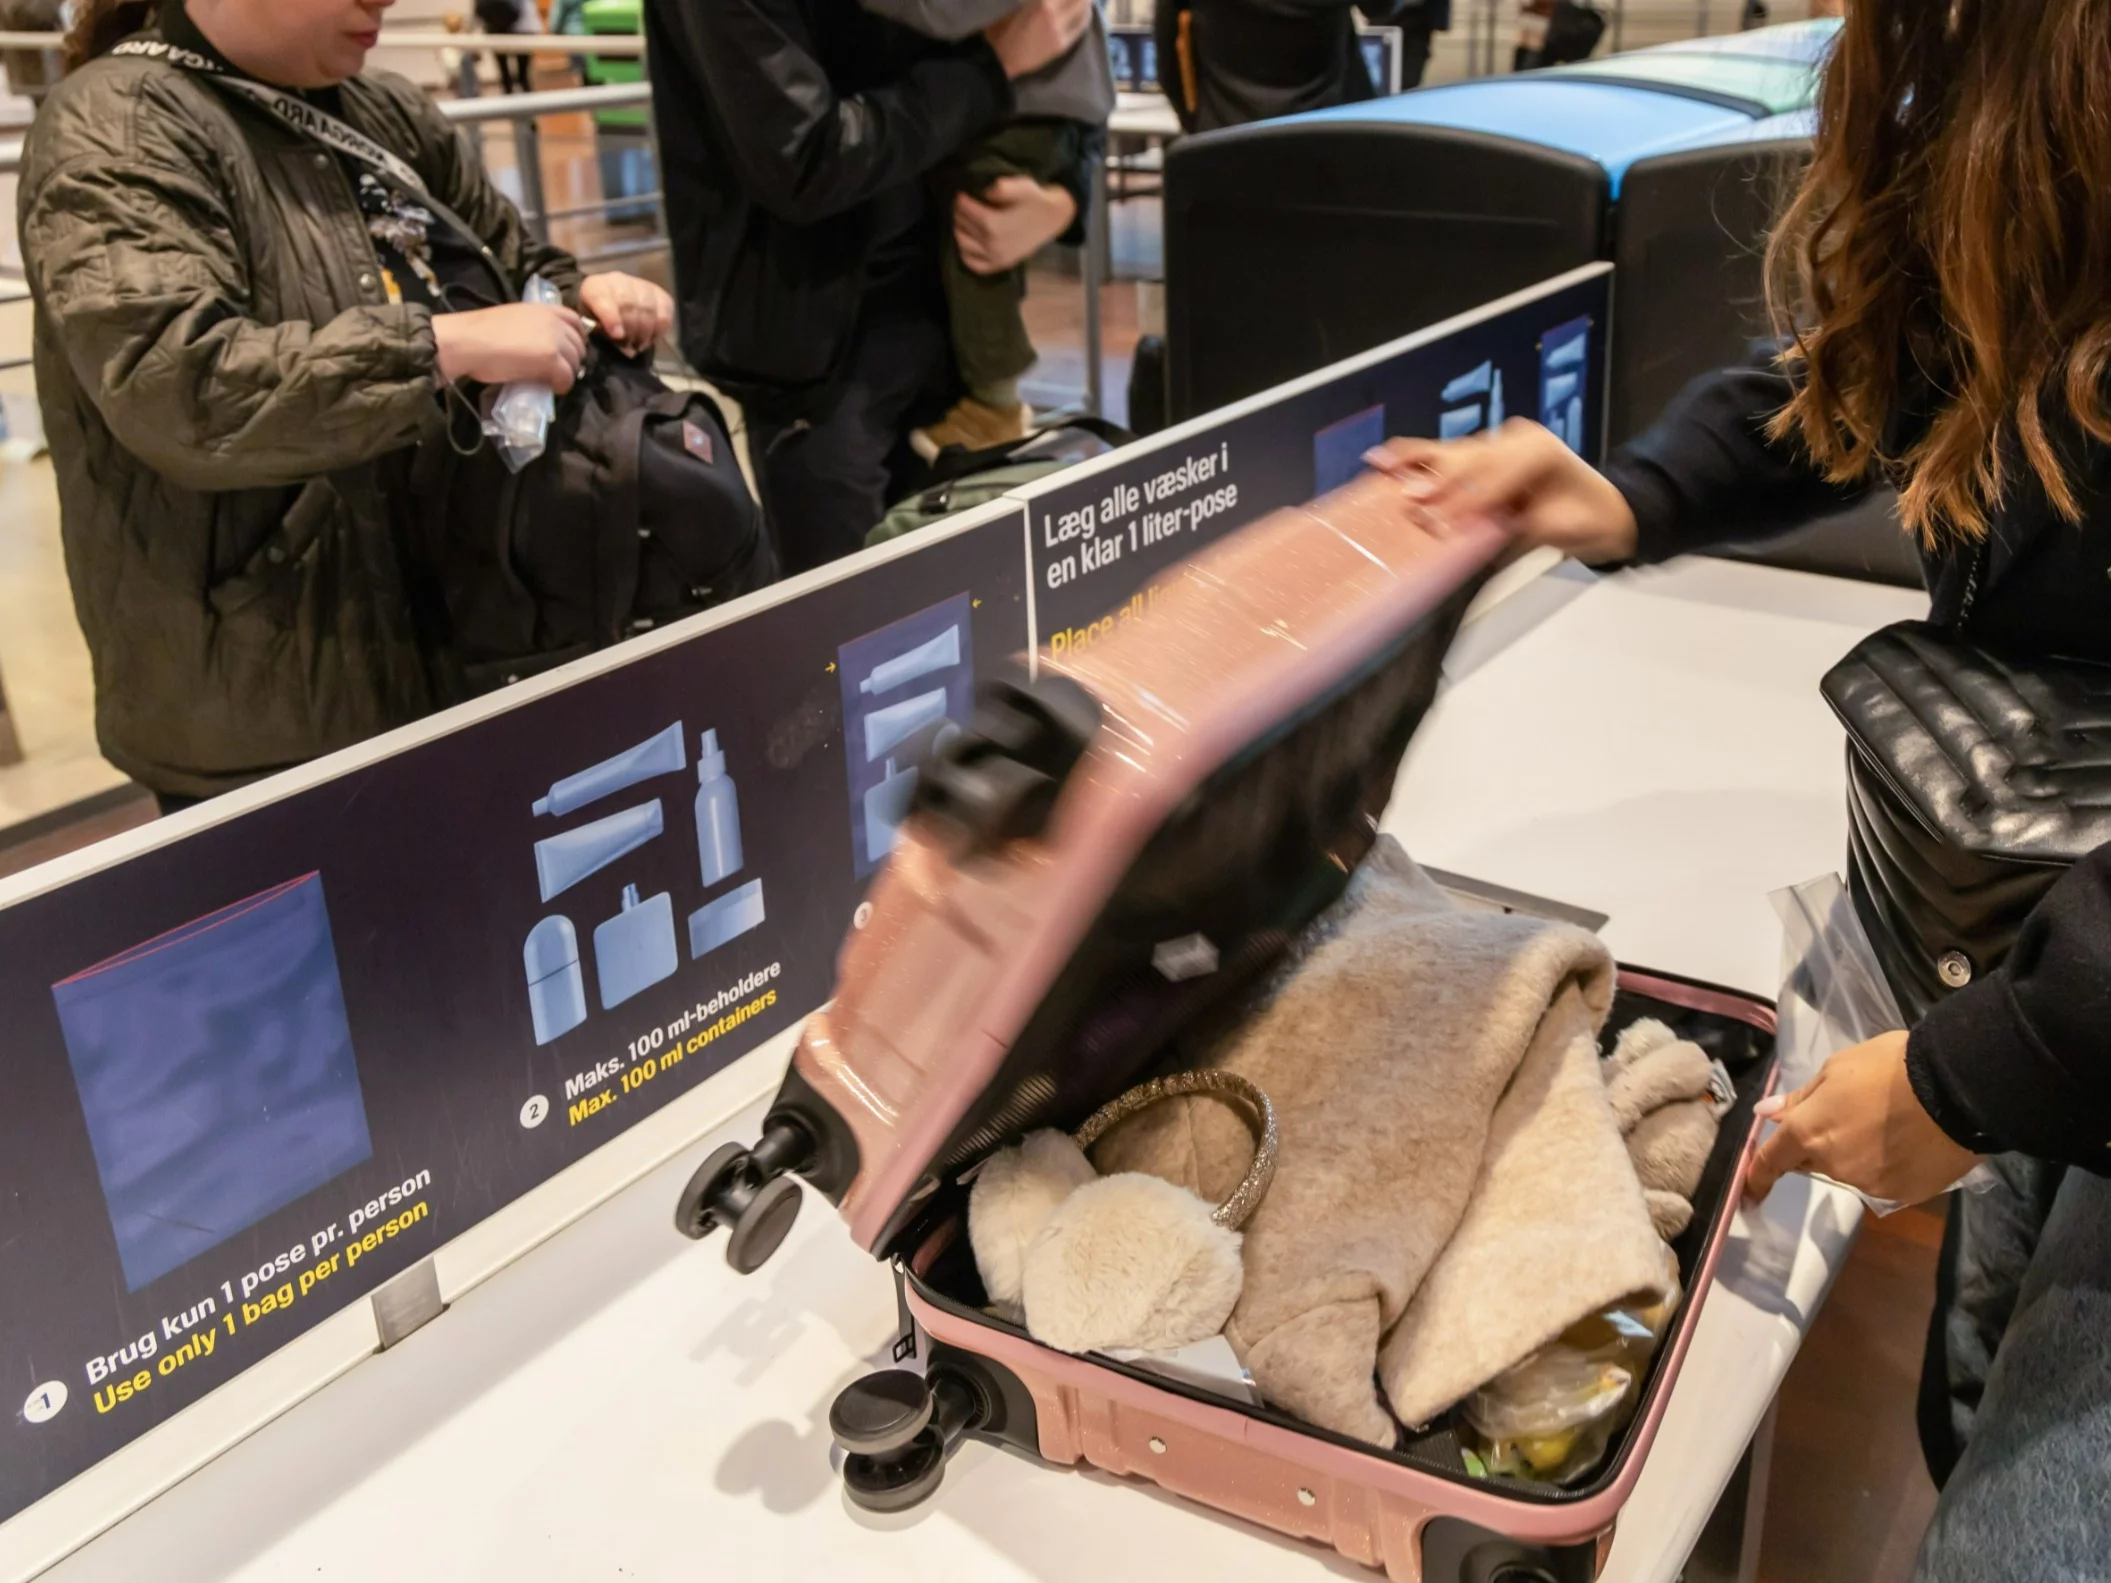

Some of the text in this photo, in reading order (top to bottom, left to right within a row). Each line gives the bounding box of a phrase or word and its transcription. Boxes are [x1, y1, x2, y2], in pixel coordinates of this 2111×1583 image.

[1044, 441, 1228, 548] Læg alle væsker i
[1047, 484, 1238, 589] en klar 1 liter-pose
[1051, 615, 1113, 663] Place
[530, 988, 777, 1126] 2 Max. 100 ml containers
[565, 961, 781, 1100] Maks. 100 ml-beholdere
[41, 1201, 428, 1414] 1 Use only 1 bag per person
[85, 1168, 431, 1386] Brug kun 1 pose pr. person
